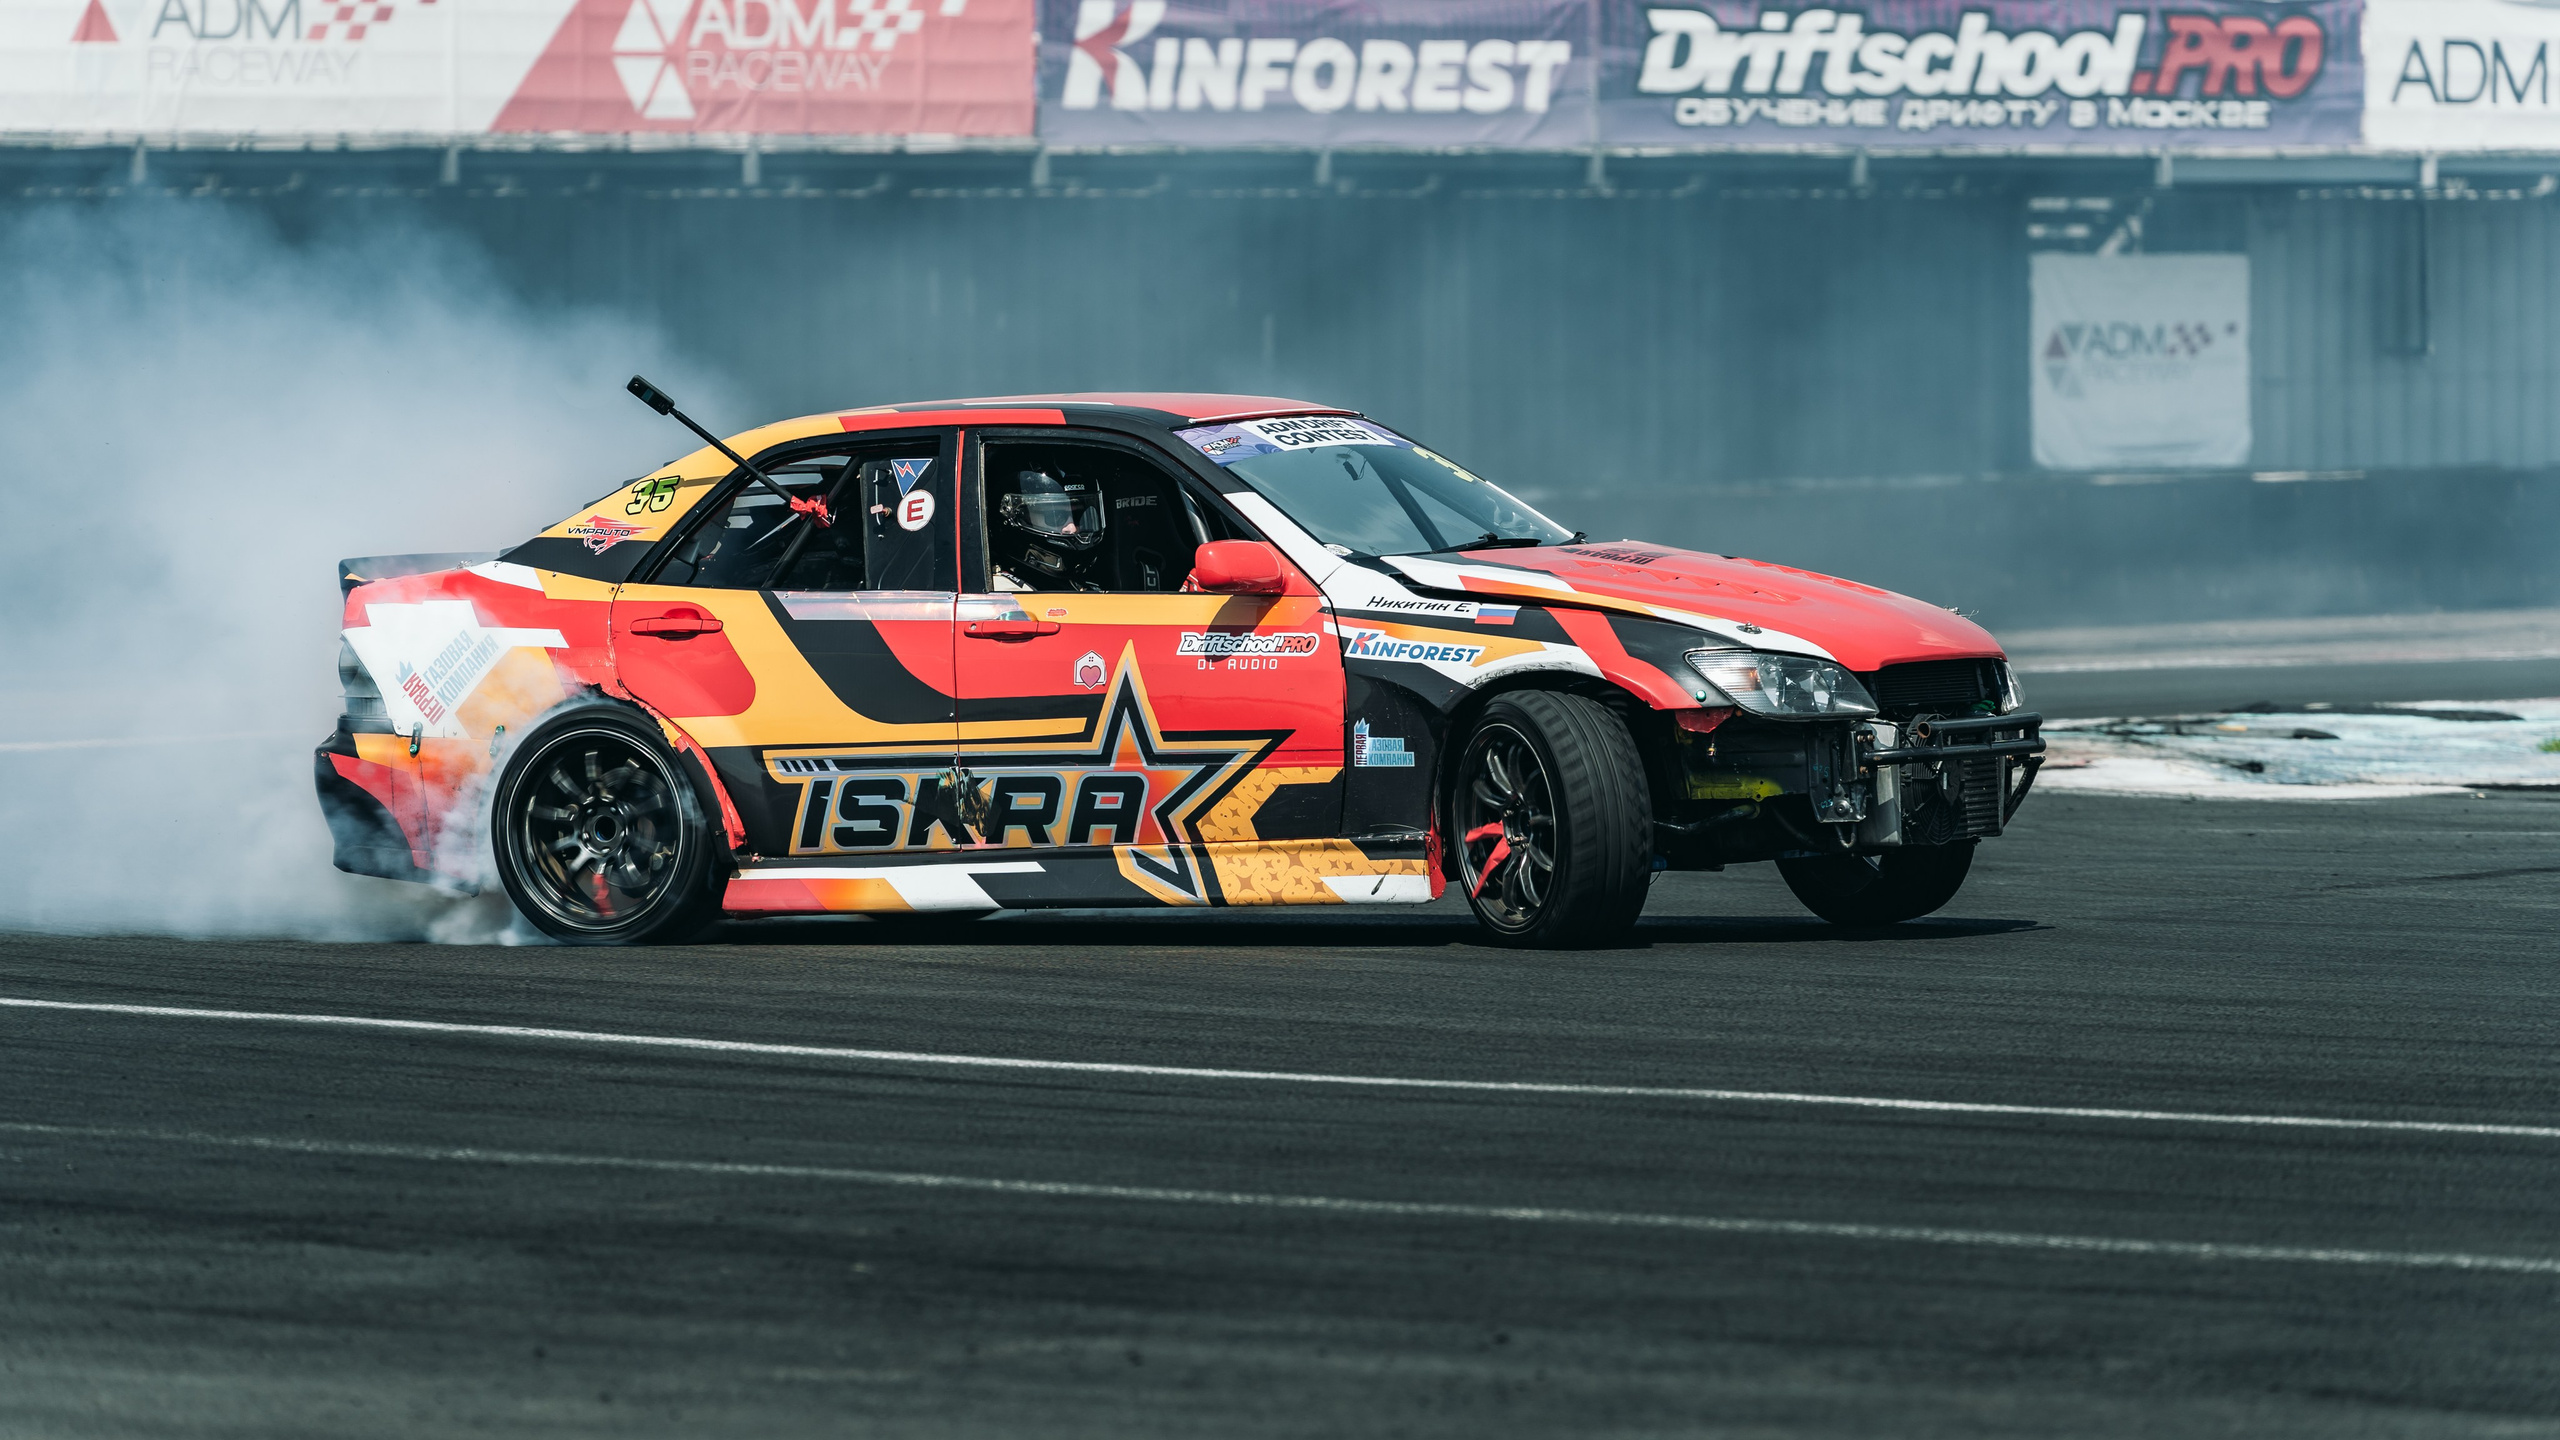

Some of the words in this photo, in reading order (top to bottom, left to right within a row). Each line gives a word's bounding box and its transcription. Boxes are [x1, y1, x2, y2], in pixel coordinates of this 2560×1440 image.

[150, 0, 301, 41] ADM
[688, 0, 837, 51] ADM
[146, 46, 361, 86] RACEWAY
[687, 51, 890, 92] RACEWAY
[1062, 0, 1572, 114] KINFOREST
[2392, 39, 2549, 105] ADM
[1675, 98, 1888, 127] ОБУЧЕНИЕ
[1898, 99, 2059, 131] ДРИФТУ
[2069, 101, 2098, 128] В
[1256, 420, 1308, 435] ADM
[1302, 418, 1356, 430] DRIFT
[1274, 429, 1378, 447] CONTEST
[625, 475, 681, 515] 35
[906, 498, 925, 523] E
[1115, 495, 1158, 510] BRIDE
[568, 527, 631, 537] VMPAUTO
[422, 629, 475, 689] ГАЗОВАЯ
[1180, 635, 1317, 654] Driftschool.PRO
[1350, 632, 1481, 663] KINFOREST
[436, 634, 499, 706] КОМПАНИЯ
[1227, 658, 1279, 670] AUDIO
[402, 672, 447, 726] ПЕРВАЯ
[1356, 734, 1368, 765] ПЕРВАЯ
[1368, 753, 1413, 765] КОМПАНИЯ
[799, 773, 1149, 850] ISKRA
